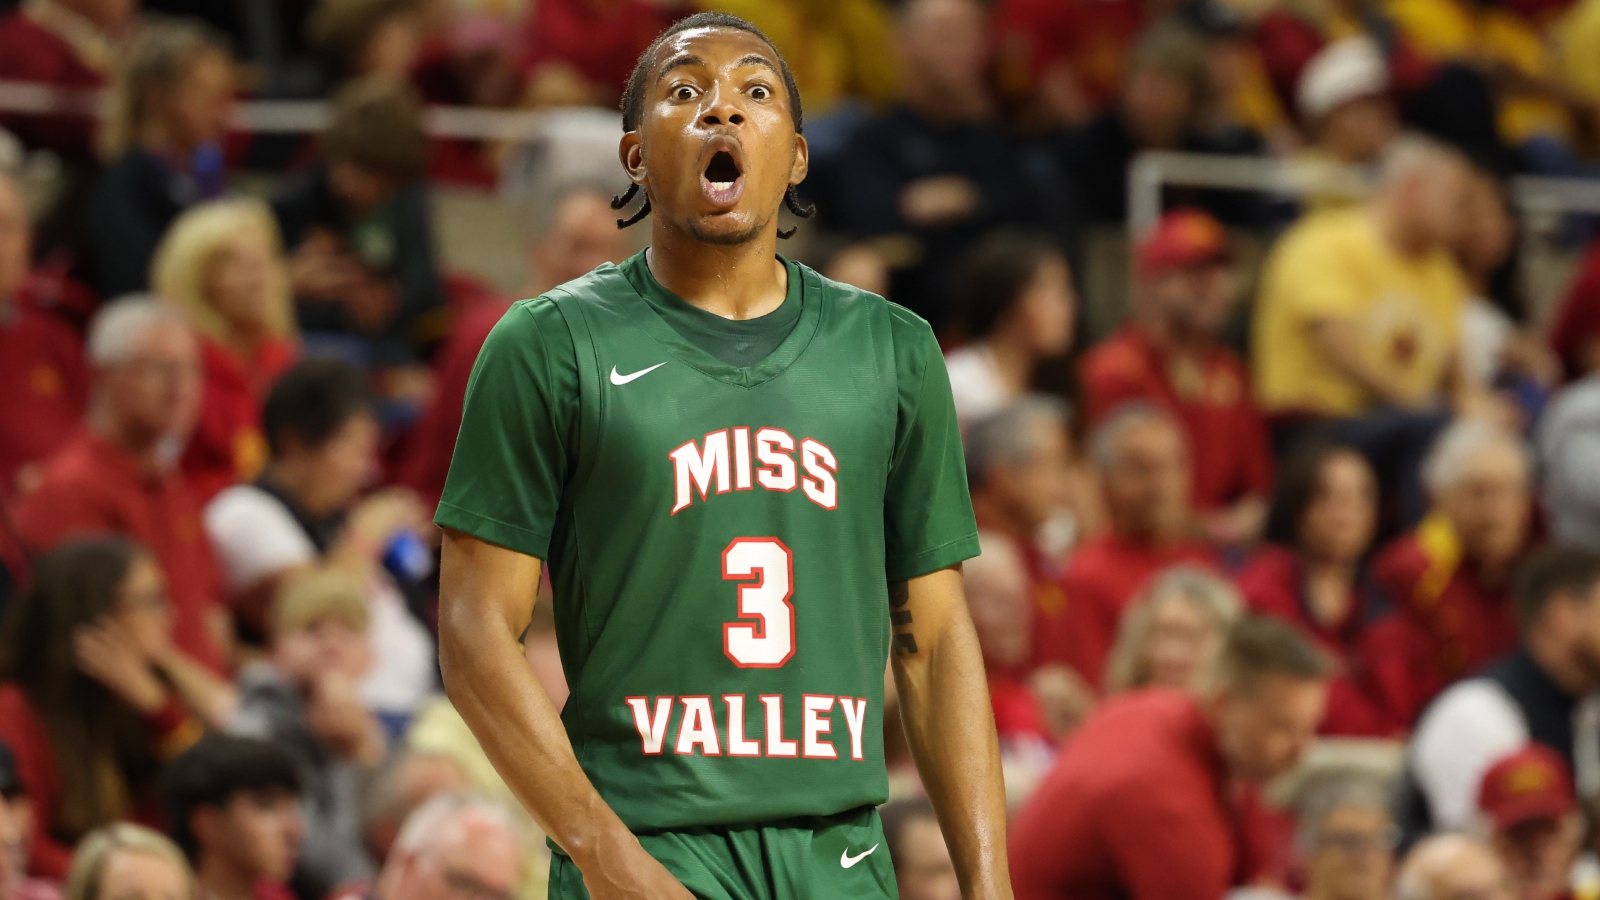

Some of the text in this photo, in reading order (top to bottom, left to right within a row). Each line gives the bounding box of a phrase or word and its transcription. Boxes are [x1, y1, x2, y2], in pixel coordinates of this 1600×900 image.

[668, 426, 838, 516] MISS
[721, 536, 796, 669] 3
[625, 694, 867, 761] VALLEY
